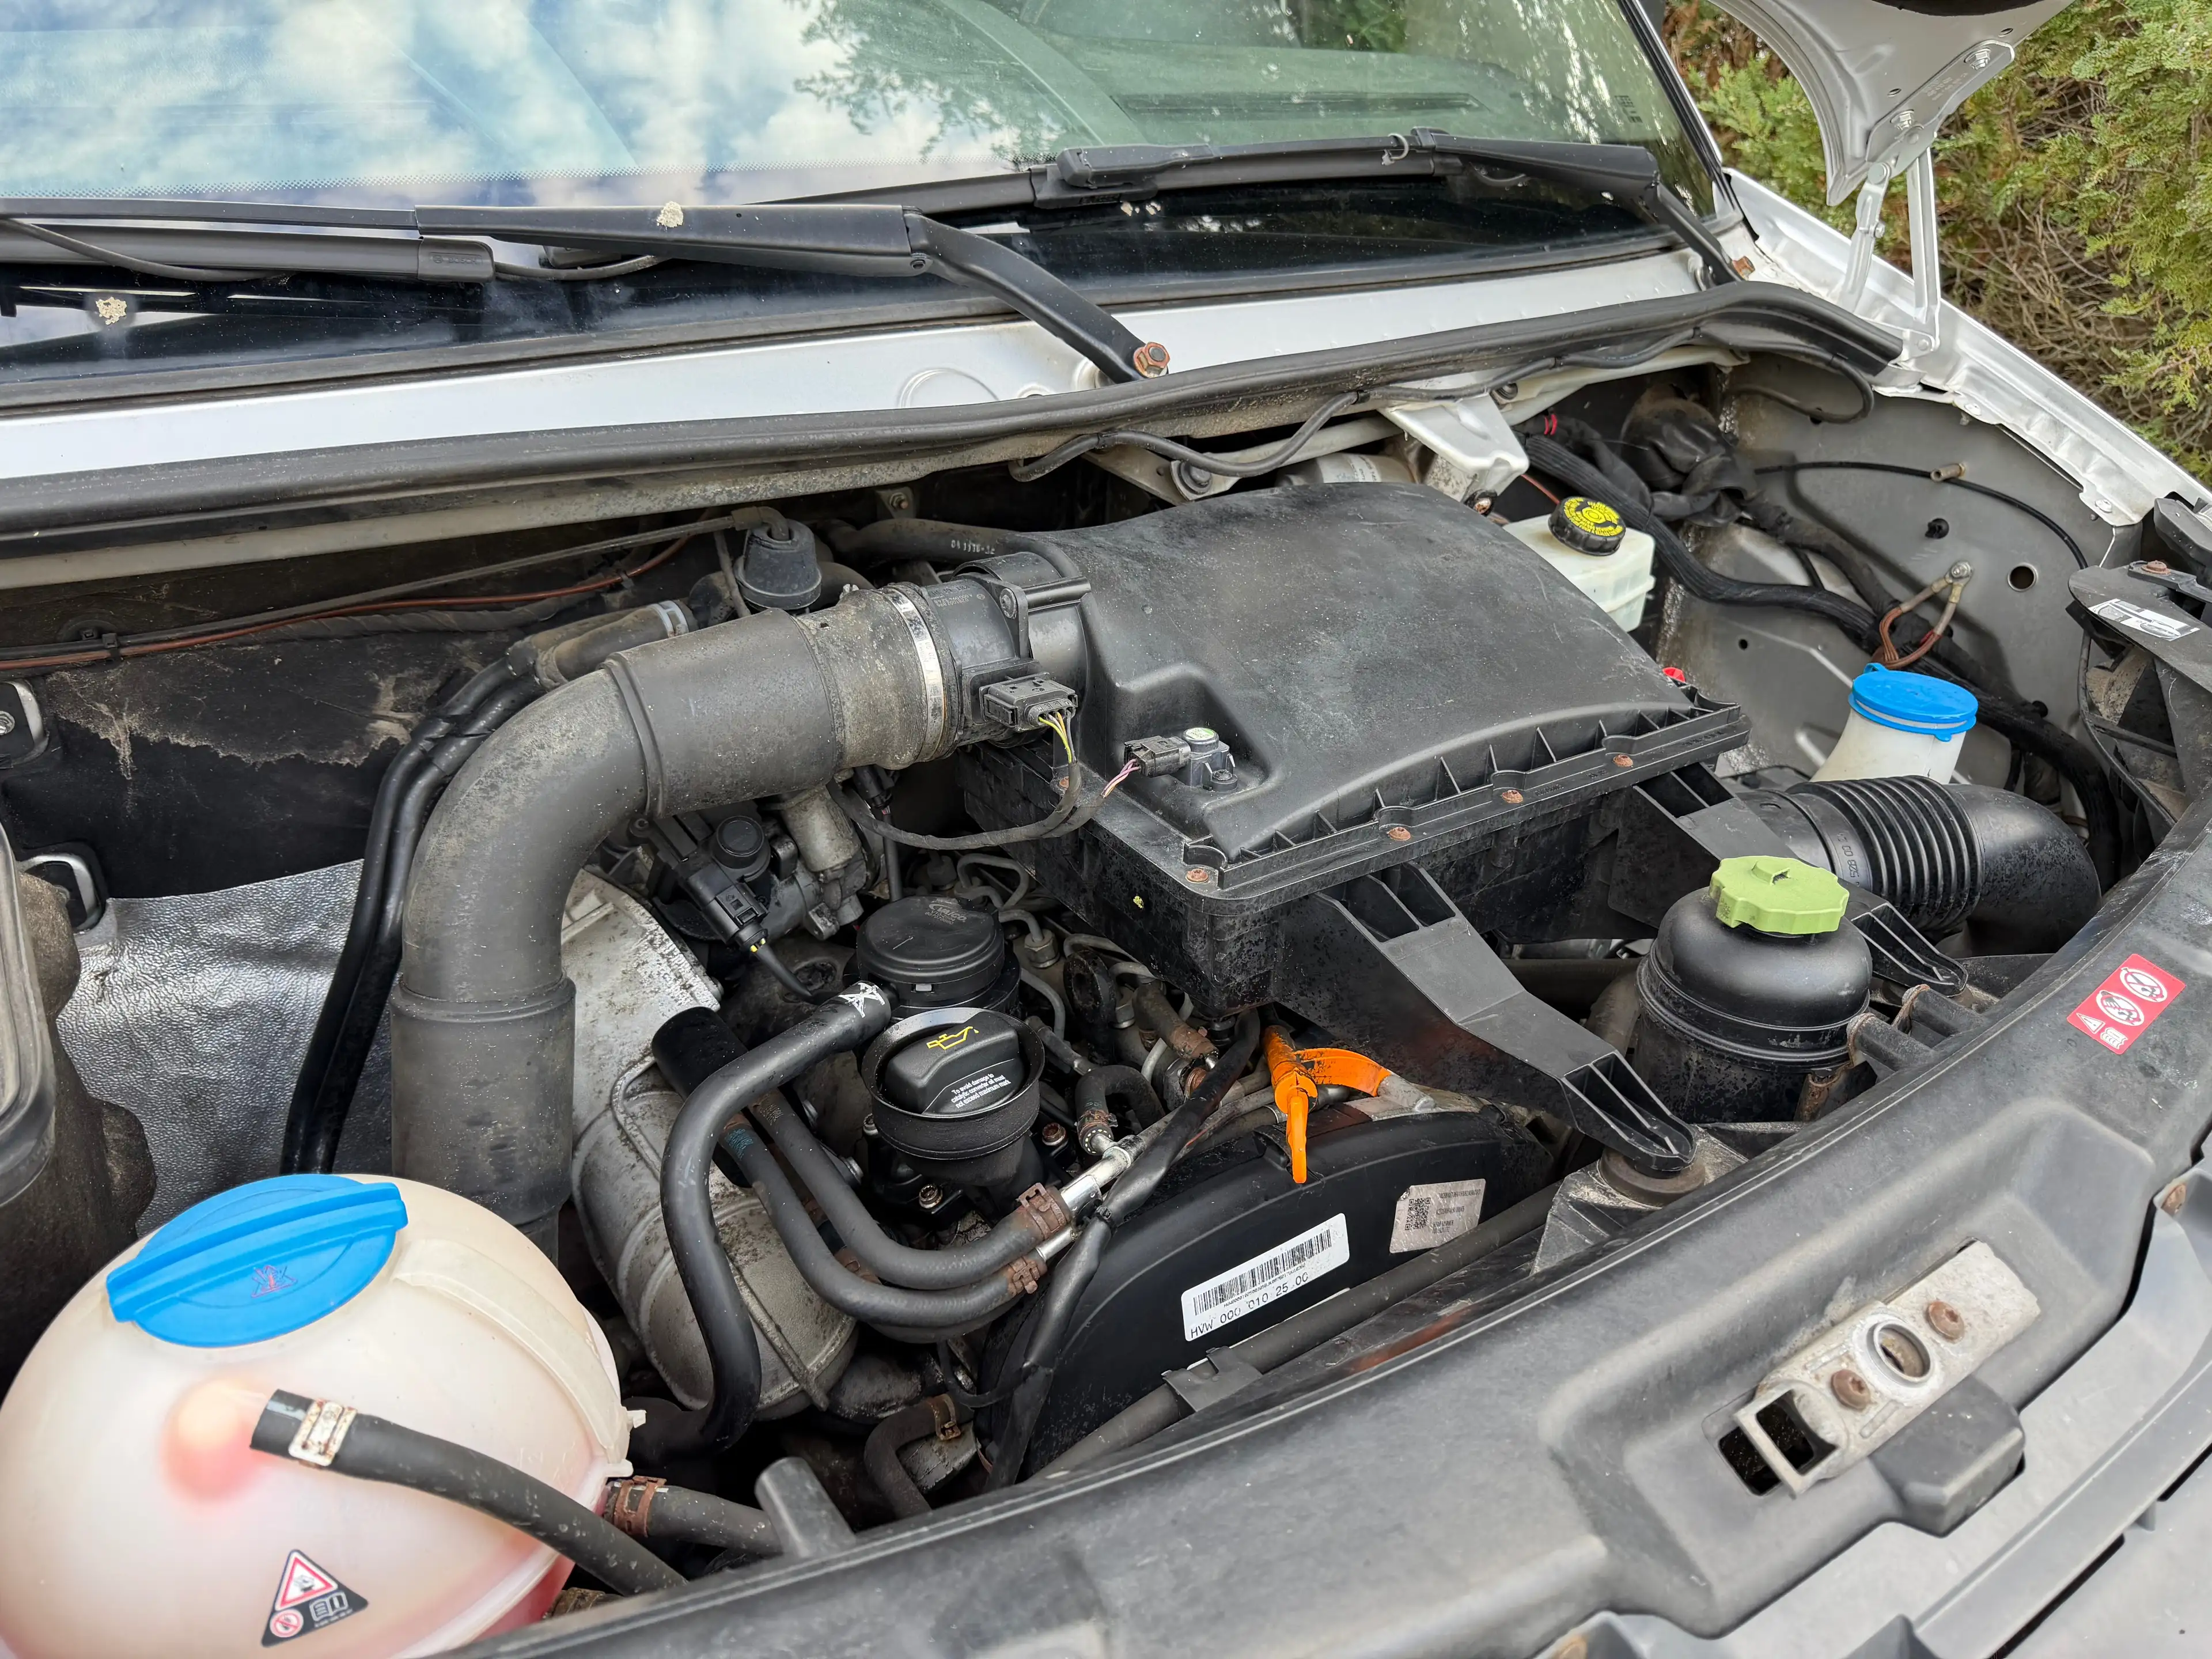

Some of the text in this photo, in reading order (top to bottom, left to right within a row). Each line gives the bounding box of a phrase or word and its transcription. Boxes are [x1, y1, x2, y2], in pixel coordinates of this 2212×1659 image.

[951, 1091, 970, 1103] catalytic
[968, 1082, 989, 1094] converter
[994, 1074, 1006, 1082] must
[956, 1100, 965, 1108] not
[963, 1092, 980, 1104] exceed
[978, 1084, 1001, 1096] maximum
[959, 1082, 973, 1092] avoid
[972, 1075, 990, 1085] damage
[1191, 1319, 1213, 1338] HVW
[1220, 1308, 1241, 1324] 000
[1275, 1282, 1289, 1297] 25
